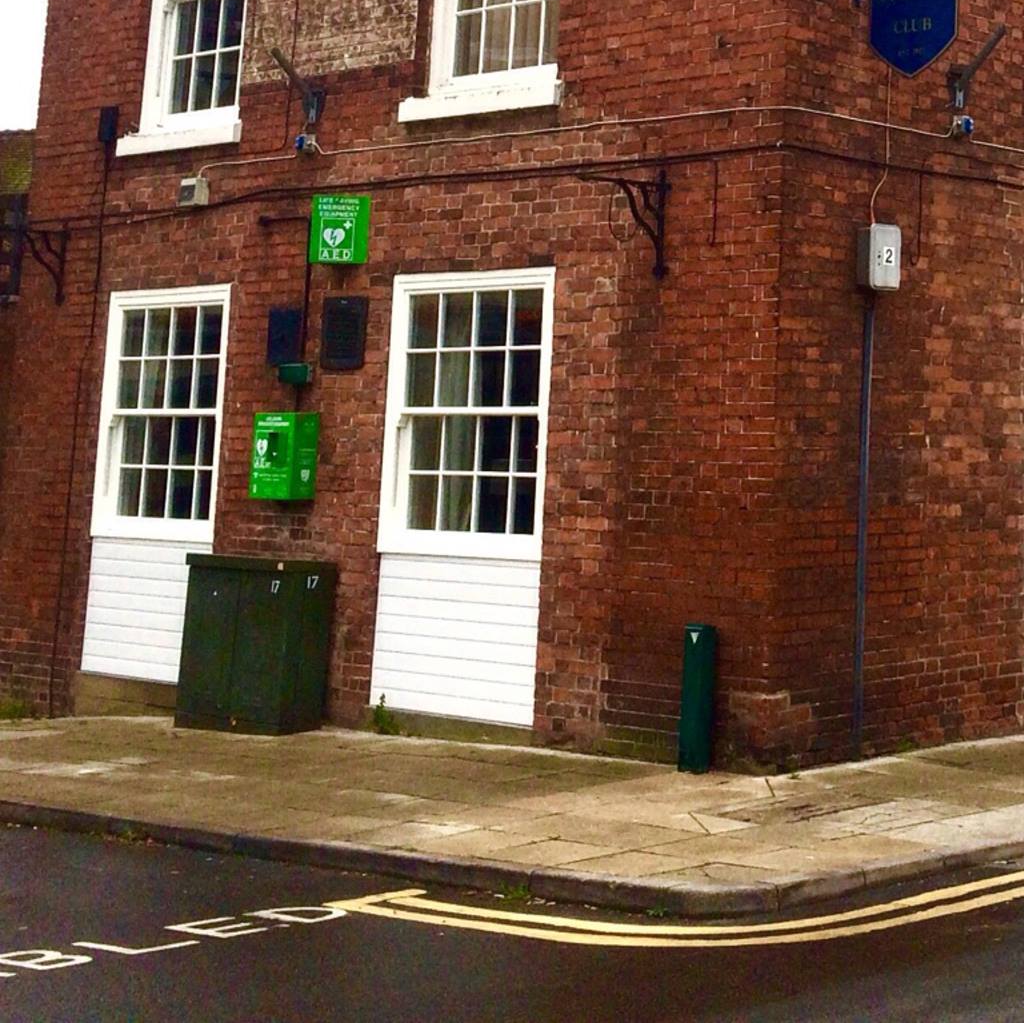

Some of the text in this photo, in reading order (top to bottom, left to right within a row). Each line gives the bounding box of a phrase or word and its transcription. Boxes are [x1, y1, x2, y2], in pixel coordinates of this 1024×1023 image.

[893, 17, 932, 34] CLUB
[321, 249, 352, 260] AED
[885, 248, 893, 264] 2
[271, 580, 281, 594] 17
[307, 575, 319, 589] 17
[0, 906, 348, 977] BLED
